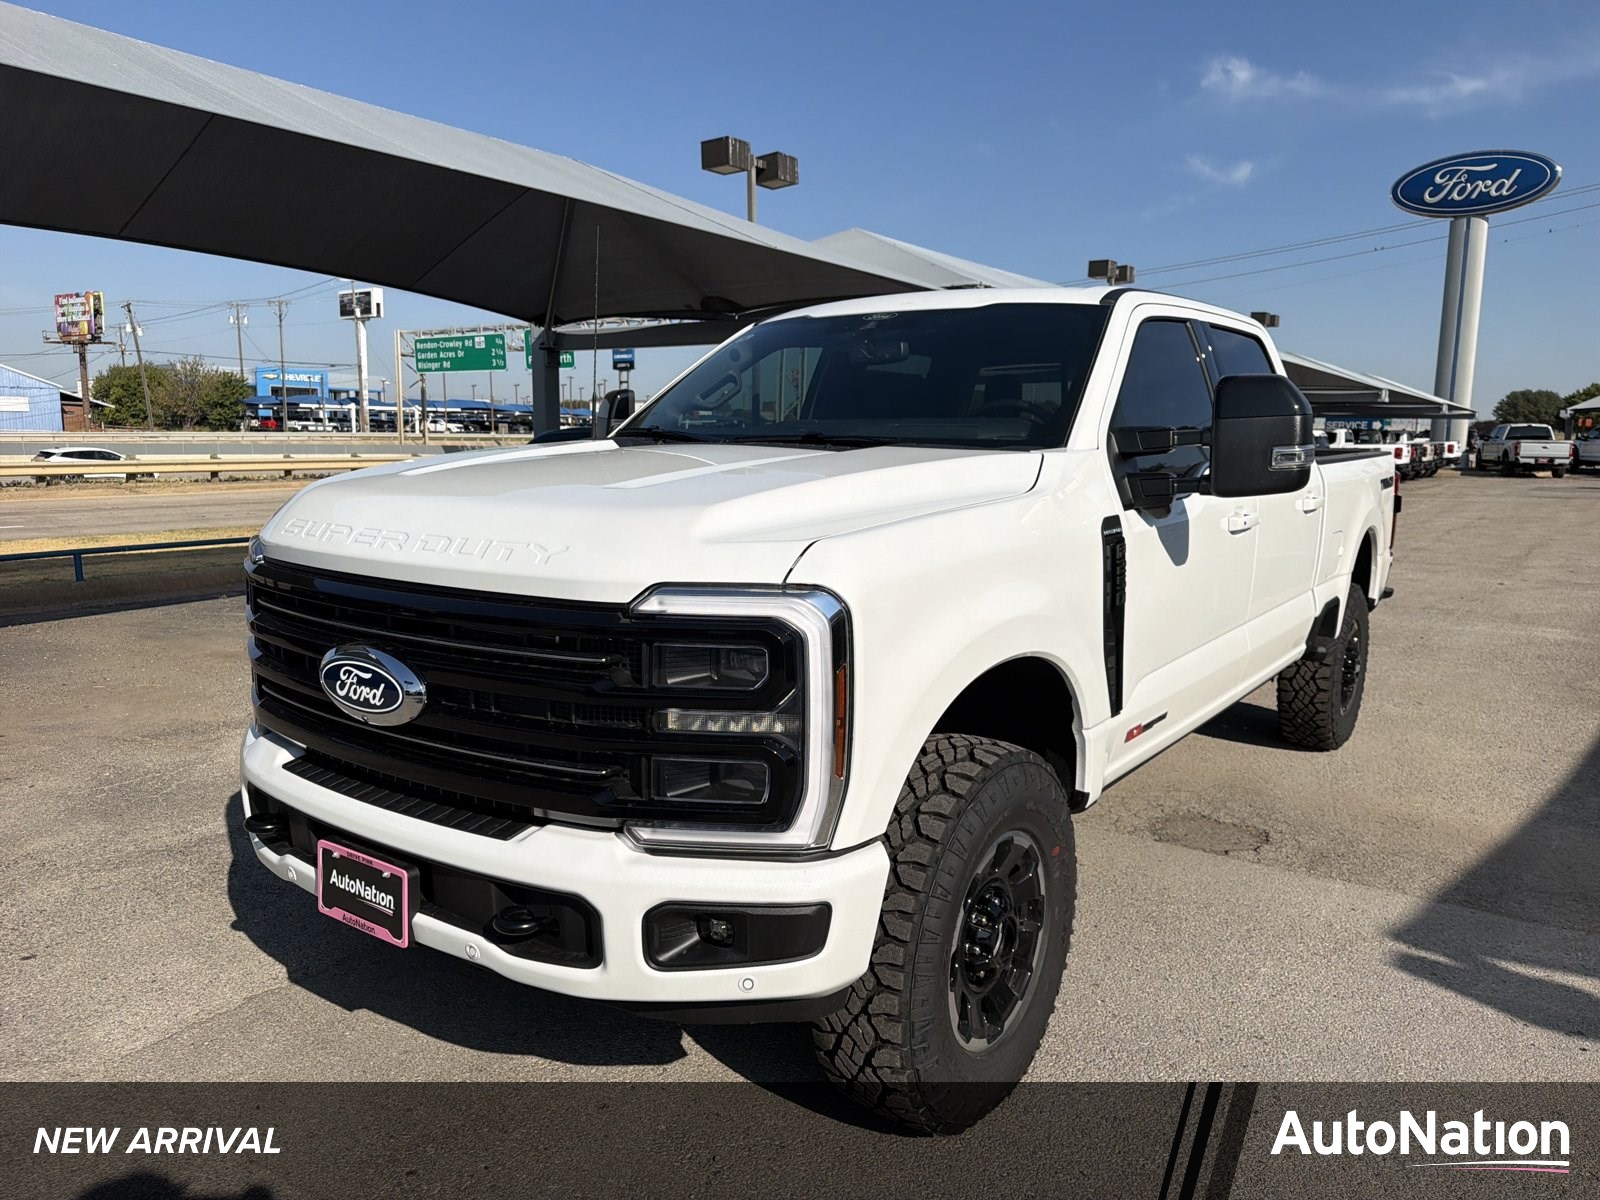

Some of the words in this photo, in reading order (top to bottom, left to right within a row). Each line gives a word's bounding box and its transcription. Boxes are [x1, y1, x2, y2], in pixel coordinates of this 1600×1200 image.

[1423, 163, 1523, 204] Ford
[416, 340, 463, 350] Rendon-Crowley
[464, 339, 473, 347] Rd
[417, 352, 438, 360] Garden
[457, 350, 465, 358] Dr
[418, 361, 441, 371] Risinger
[442, 361, 451, 369] Rd
[1326, 420, 1369, 430] SERVICE
[281, 518, 410, 551] SUPER
[412, 533, 570, 566] DUTY
[335, 665, 387, 707] Ford
[329, 869, 395, 910] AutoNation
[342, 913, 376, 935] AutoNation
